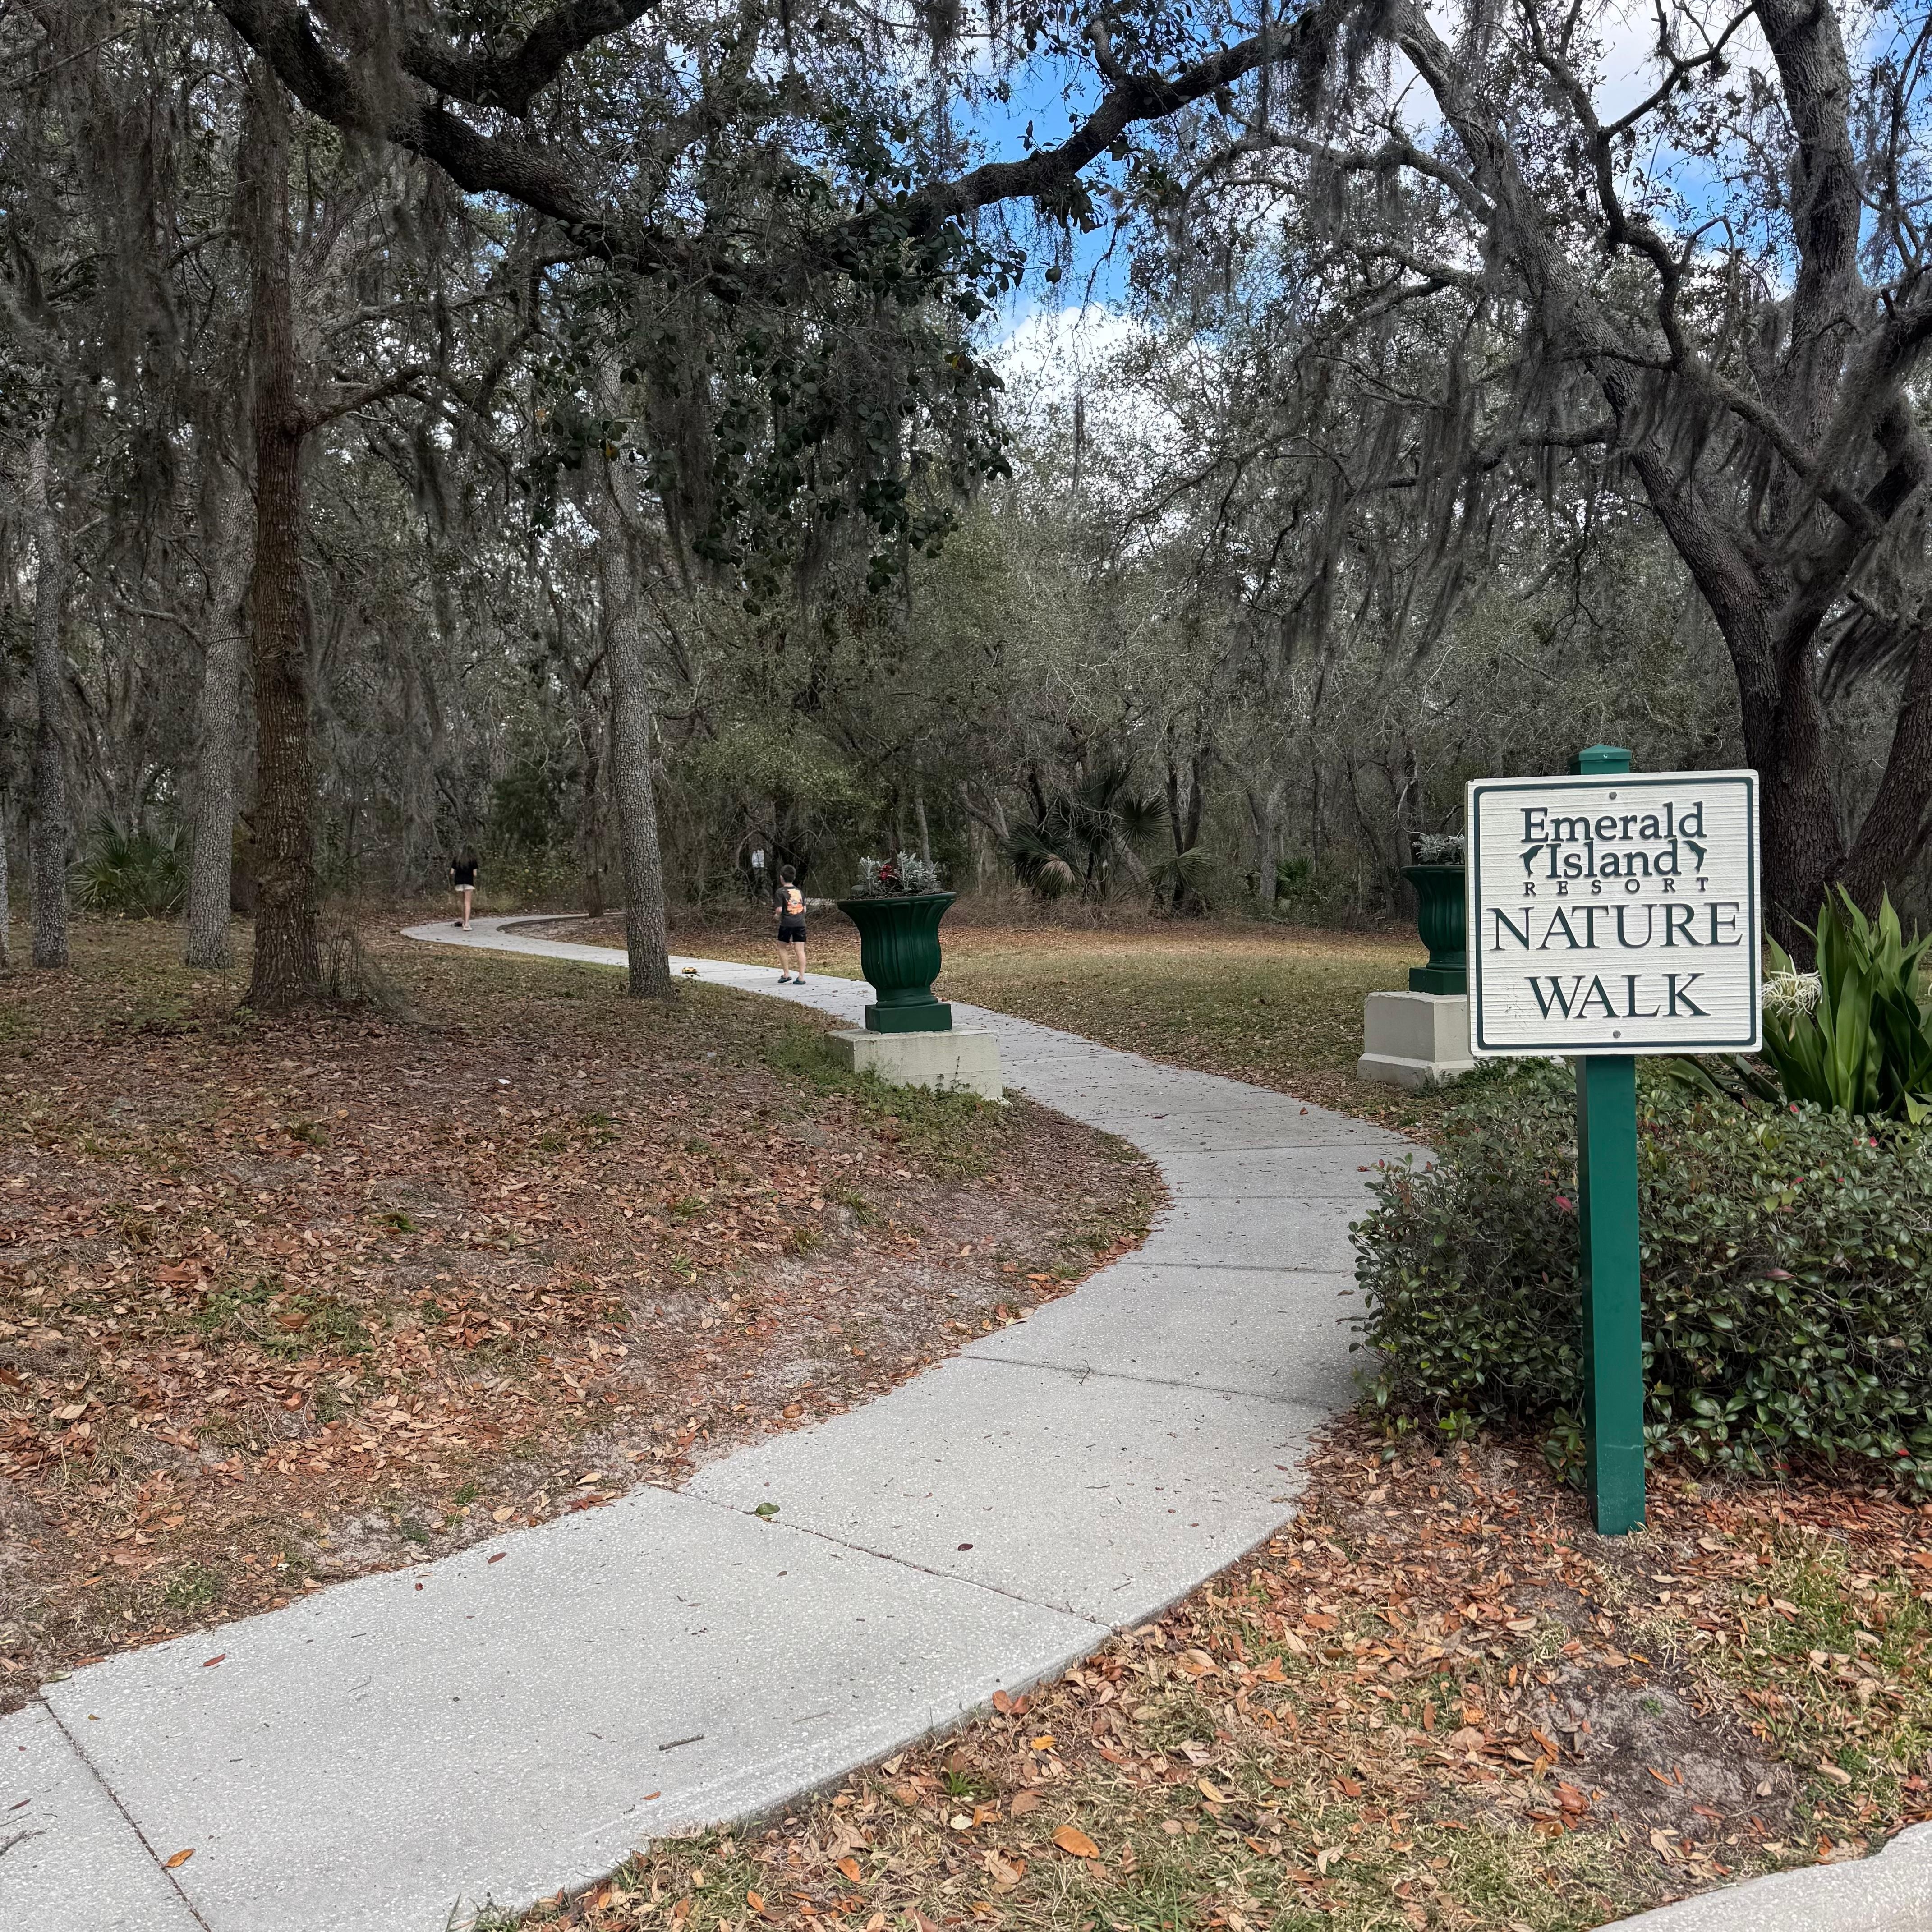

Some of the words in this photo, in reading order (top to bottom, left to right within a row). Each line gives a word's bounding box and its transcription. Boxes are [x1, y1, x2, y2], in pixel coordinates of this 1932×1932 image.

[1521, 801, 1707, 842] Emerald
[1546, 838, 1682, 879] Island
[1524, 877, 1708, 896] RESORT
[1486, 902, 1743, 951] NATURE
[1524, 973, 1711, 1020] WALK
